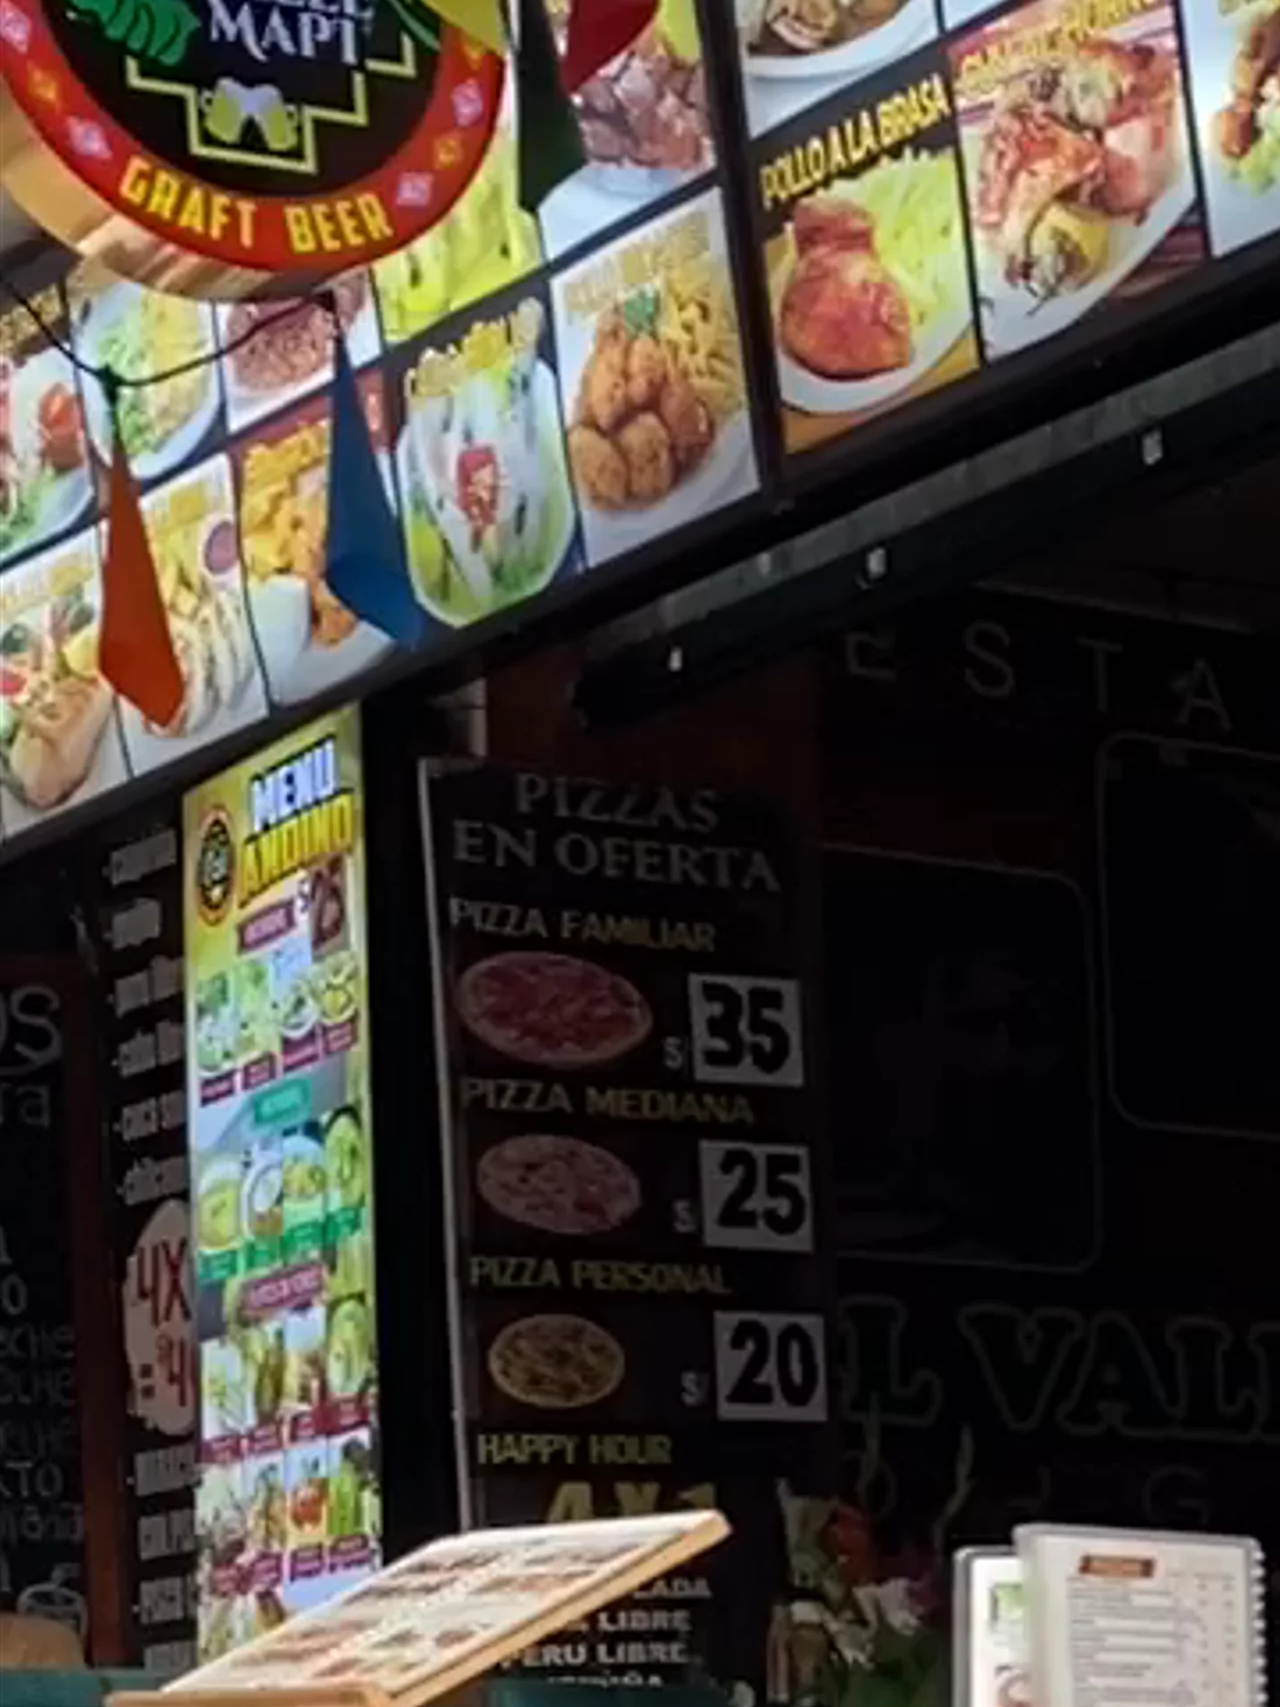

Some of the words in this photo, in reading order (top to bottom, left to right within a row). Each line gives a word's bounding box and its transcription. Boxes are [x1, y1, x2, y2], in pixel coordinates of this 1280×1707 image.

[760, 136, 825, 212] POLLO
[845, 109, 881, 164] LA
[878, 72, 950, 148] BRASA
[284, 193, 394, 253] BEER
[513, 769, 721, 833] PIZZAS
[453, 819, 536, 871] EN
[555, 831, 782, 893] OFERTA
[449, 894, 551, 941] PIZZA
[562, 910, 715, 953] FAMILIAR
[703, 983, 791, 1072] 35
[461, 1078, 570, 1116] PIZZA
[586, 1084, 754, 1125] MEDIANA
[715, 1146, 806, 1235] 25
[470, 1255, 565, 1291] PIZZA
[571, 1259, 731, 1297] PERSONAL
[726, 1320, 817, 1405] 20
[477, 1432, 580, 1466] HAPPY
[588, 1432, 674, 1466] HOUR
[596, 1608, 692, 1633] LIBRE
[597, 1640, 690, 1666] LIBRE
